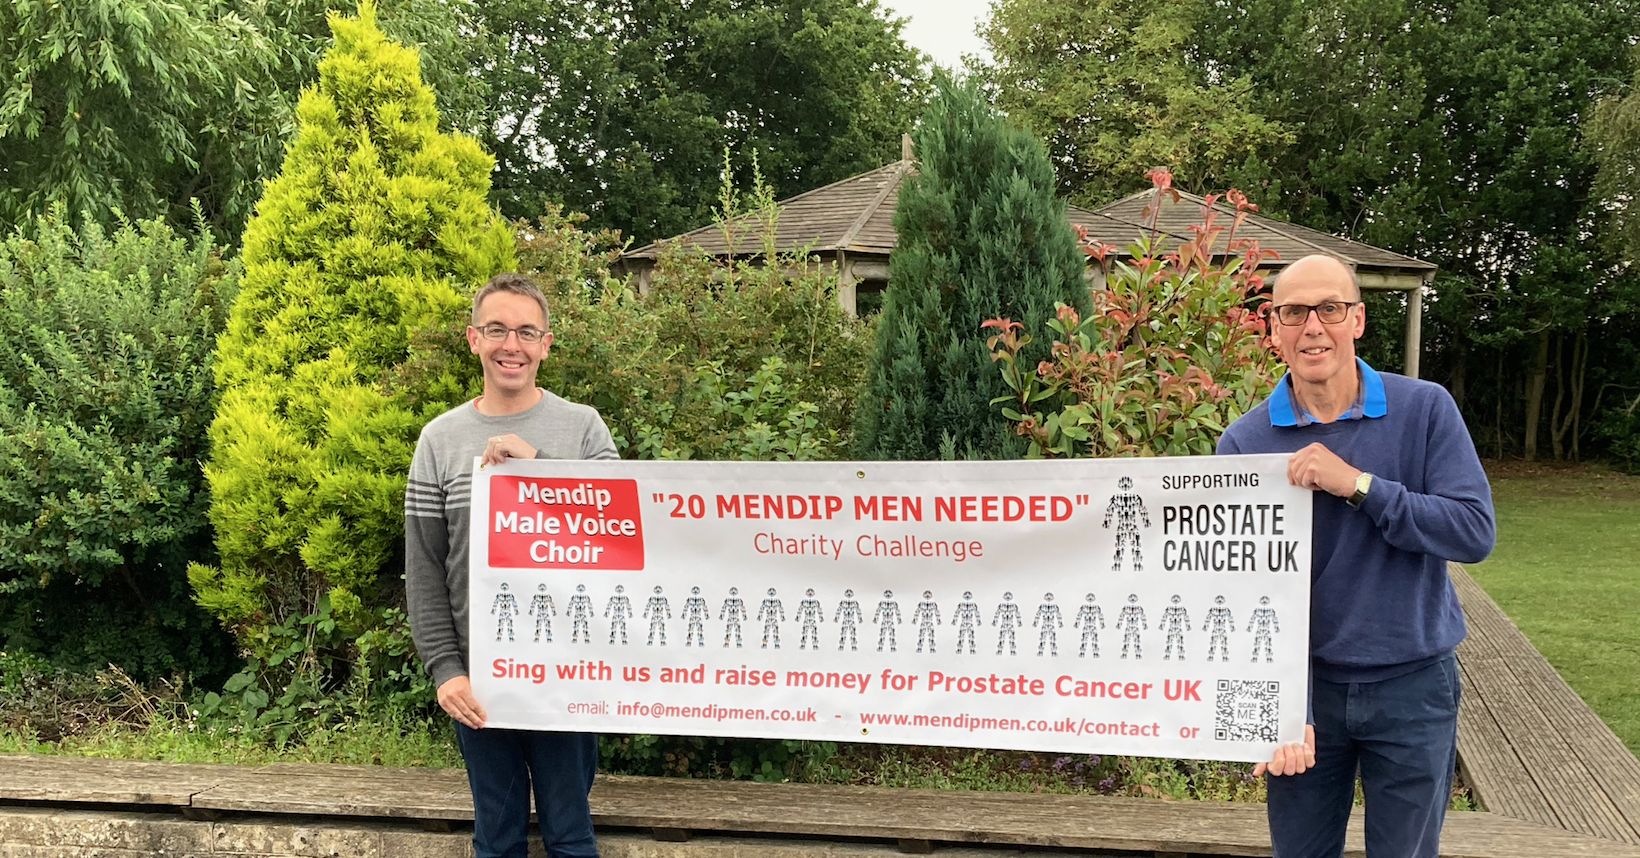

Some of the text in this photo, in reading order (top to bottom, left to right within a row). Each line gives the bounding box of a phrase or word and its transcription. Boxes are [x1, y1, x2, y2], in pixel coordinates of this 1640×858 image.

[518, 481, 612, 510] Mendip
[1162, 473, 1260, 490] SUPPORTING
[652, 493, 1090, 522] "20 MENDIP MEN NEEDED"
[1163, 504, 1285, 536] PROSTATE
[494, 511, 636, 536] Male Voice
[529, 540, 604, 564] Choir
[754, 532, 984, 562] Charity Challenge
[1163, 540, 1299, 572] CANCER UK
[492, 658, 1203, 702] Sing with us and raise money for Prostate Cancer UK
[567, 701, 609, 715] email:
[617, 702, 817, 722] info@mendipmen.co.uk
[860, 712, 1161, 737] www.mendipmen.co.uk/contact
[1179, 726, 1200, 739] or
[1237, 709, 1257, 720] ME
